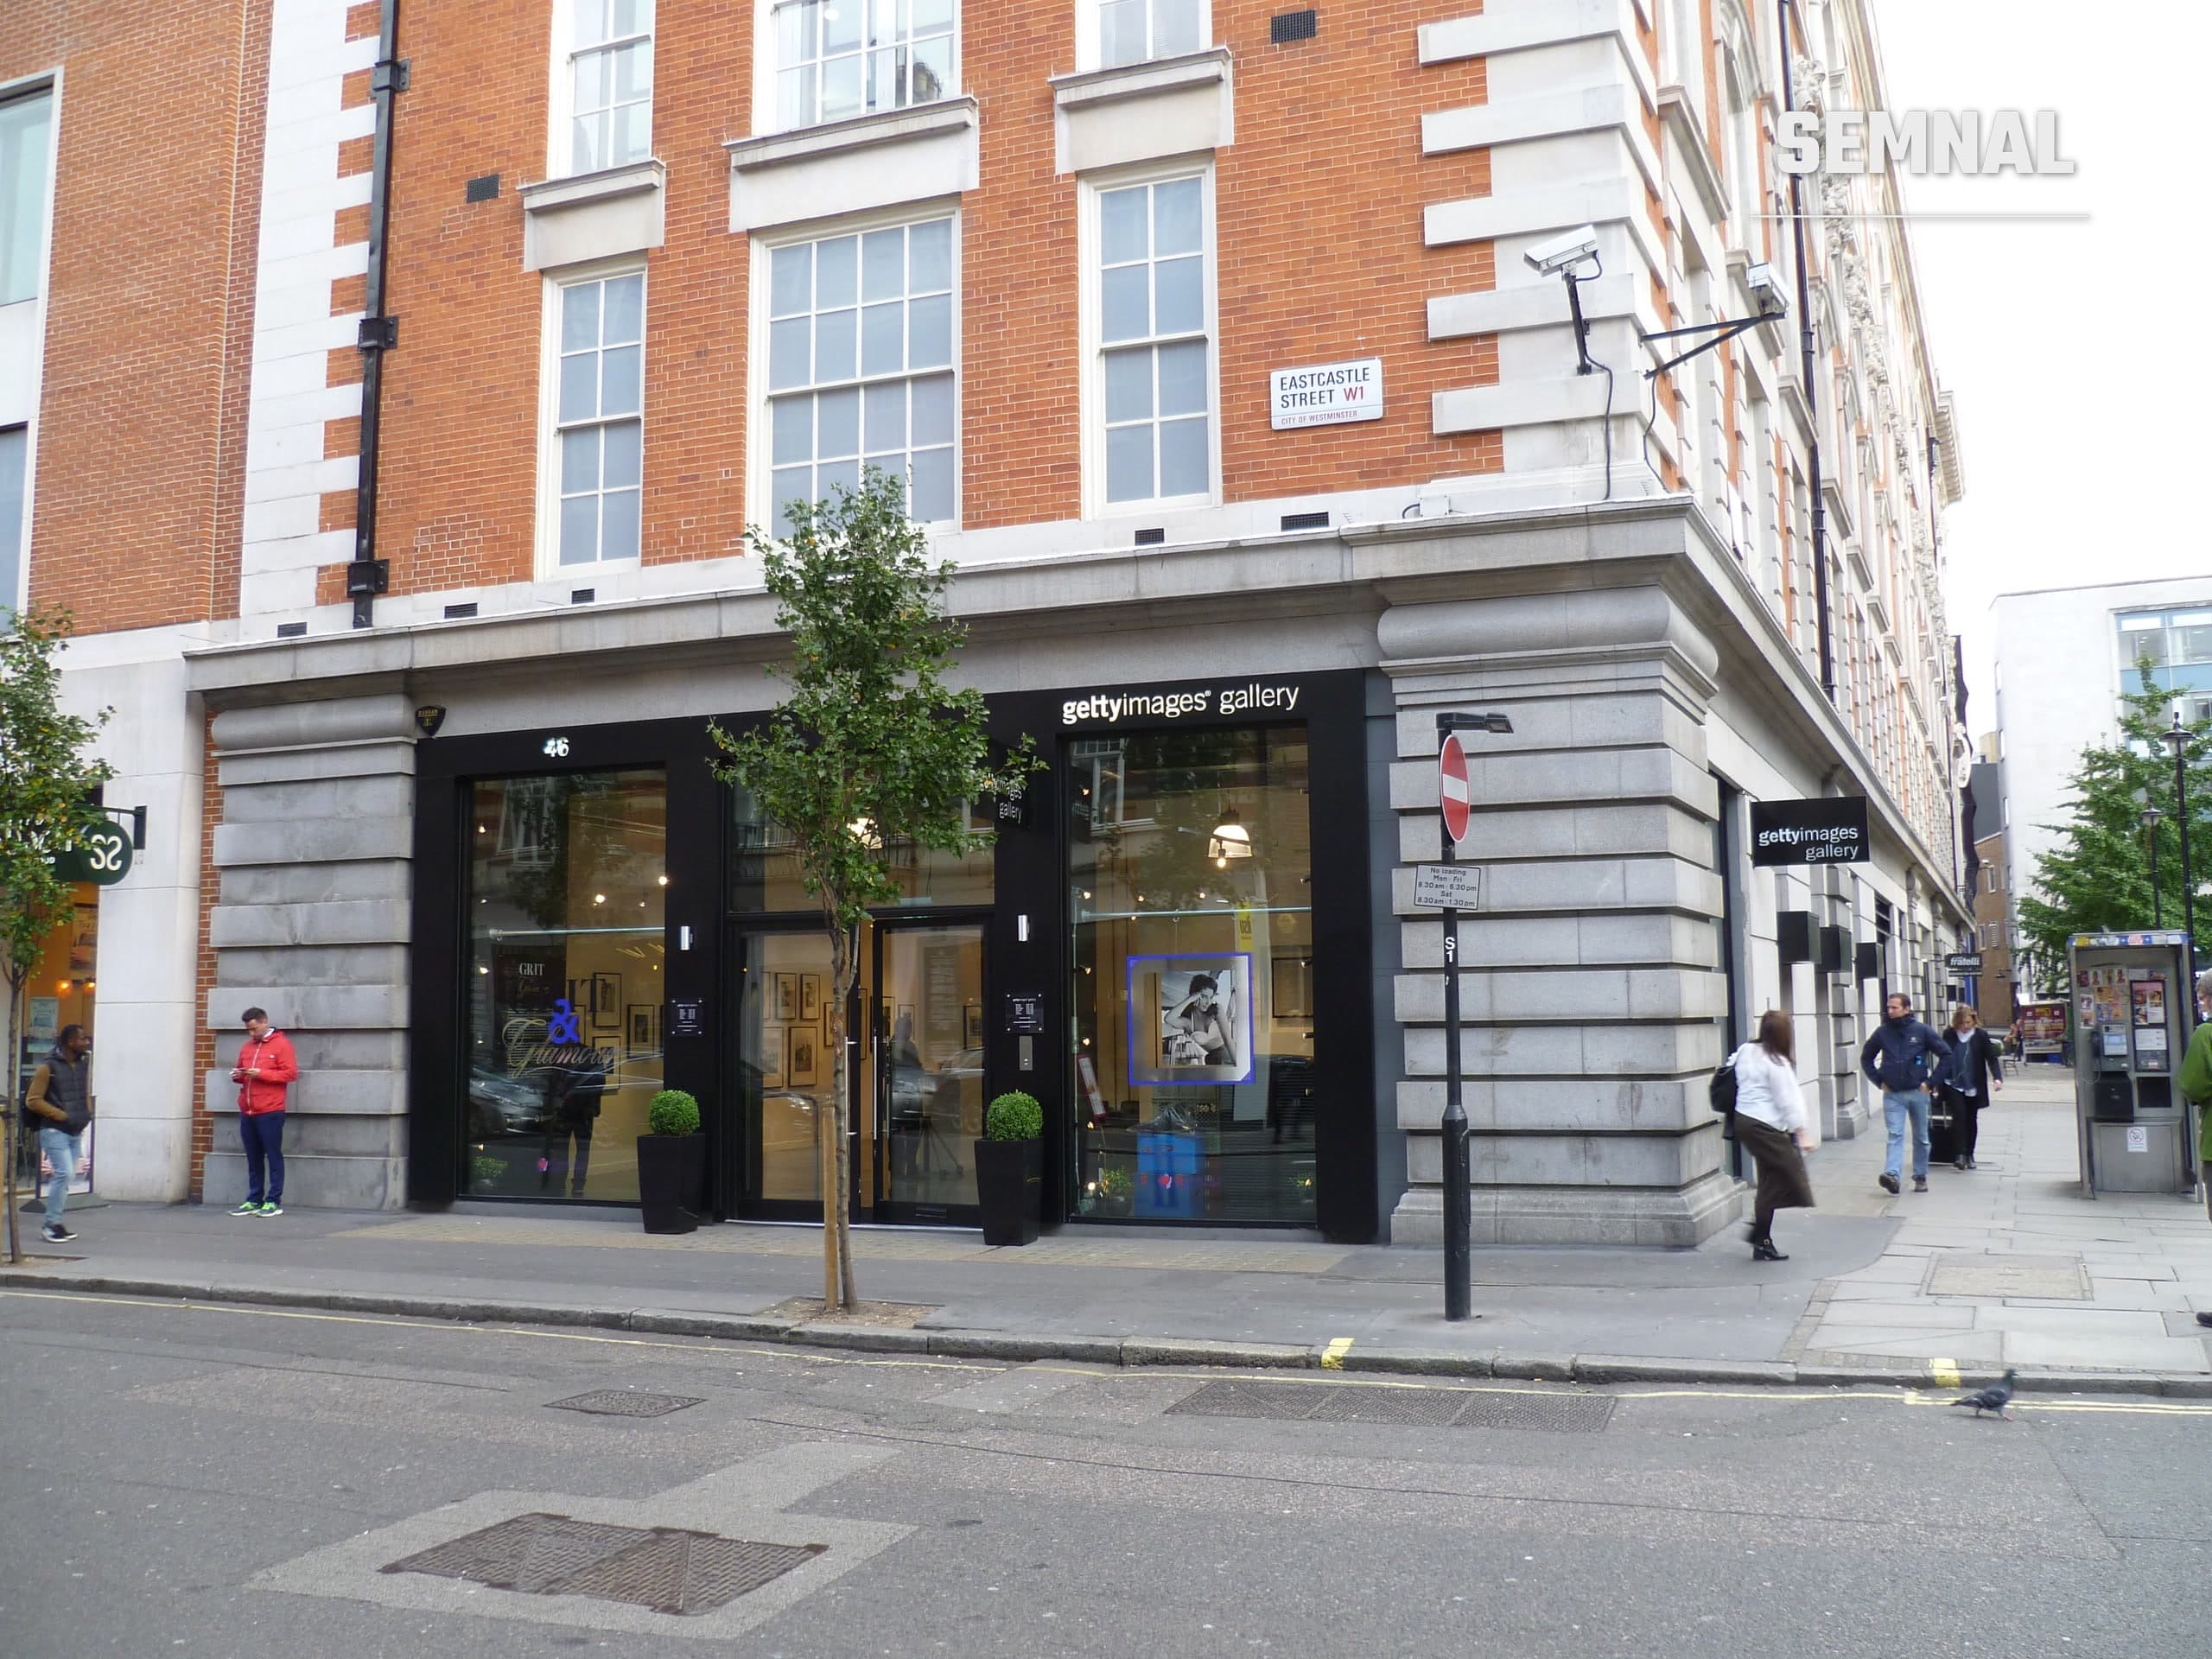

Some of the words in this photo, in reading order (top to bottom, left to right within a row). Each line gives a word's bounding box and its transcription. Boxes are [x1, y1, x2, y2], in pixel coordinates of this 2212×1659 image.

[1280, 367, 1370, 391] EASTCASTLE
[1281, 389, 1335, 409] STREET
[1344, 385, 1364, 402] W1
[1281, 416, 1296, 426] CITY
[1298, 414, 1307, 423] OF
[1309, 410, 1358, 423] WESTMINSTER
[1219, 683, 1299, 715] gallery
[543, 736, 569, 758] 46
[999, 801, 1022, 823] gallery
[1758, 827, 1859, 847] gettyimages
[1805, 843, 1859, 861] gallery
[1441, 868, 1466, 876] loading
[518, 962, 545, 976] GRIT
[1949, 957, 1980, 966] fratelli
[548, 998, 580, 1045] &
